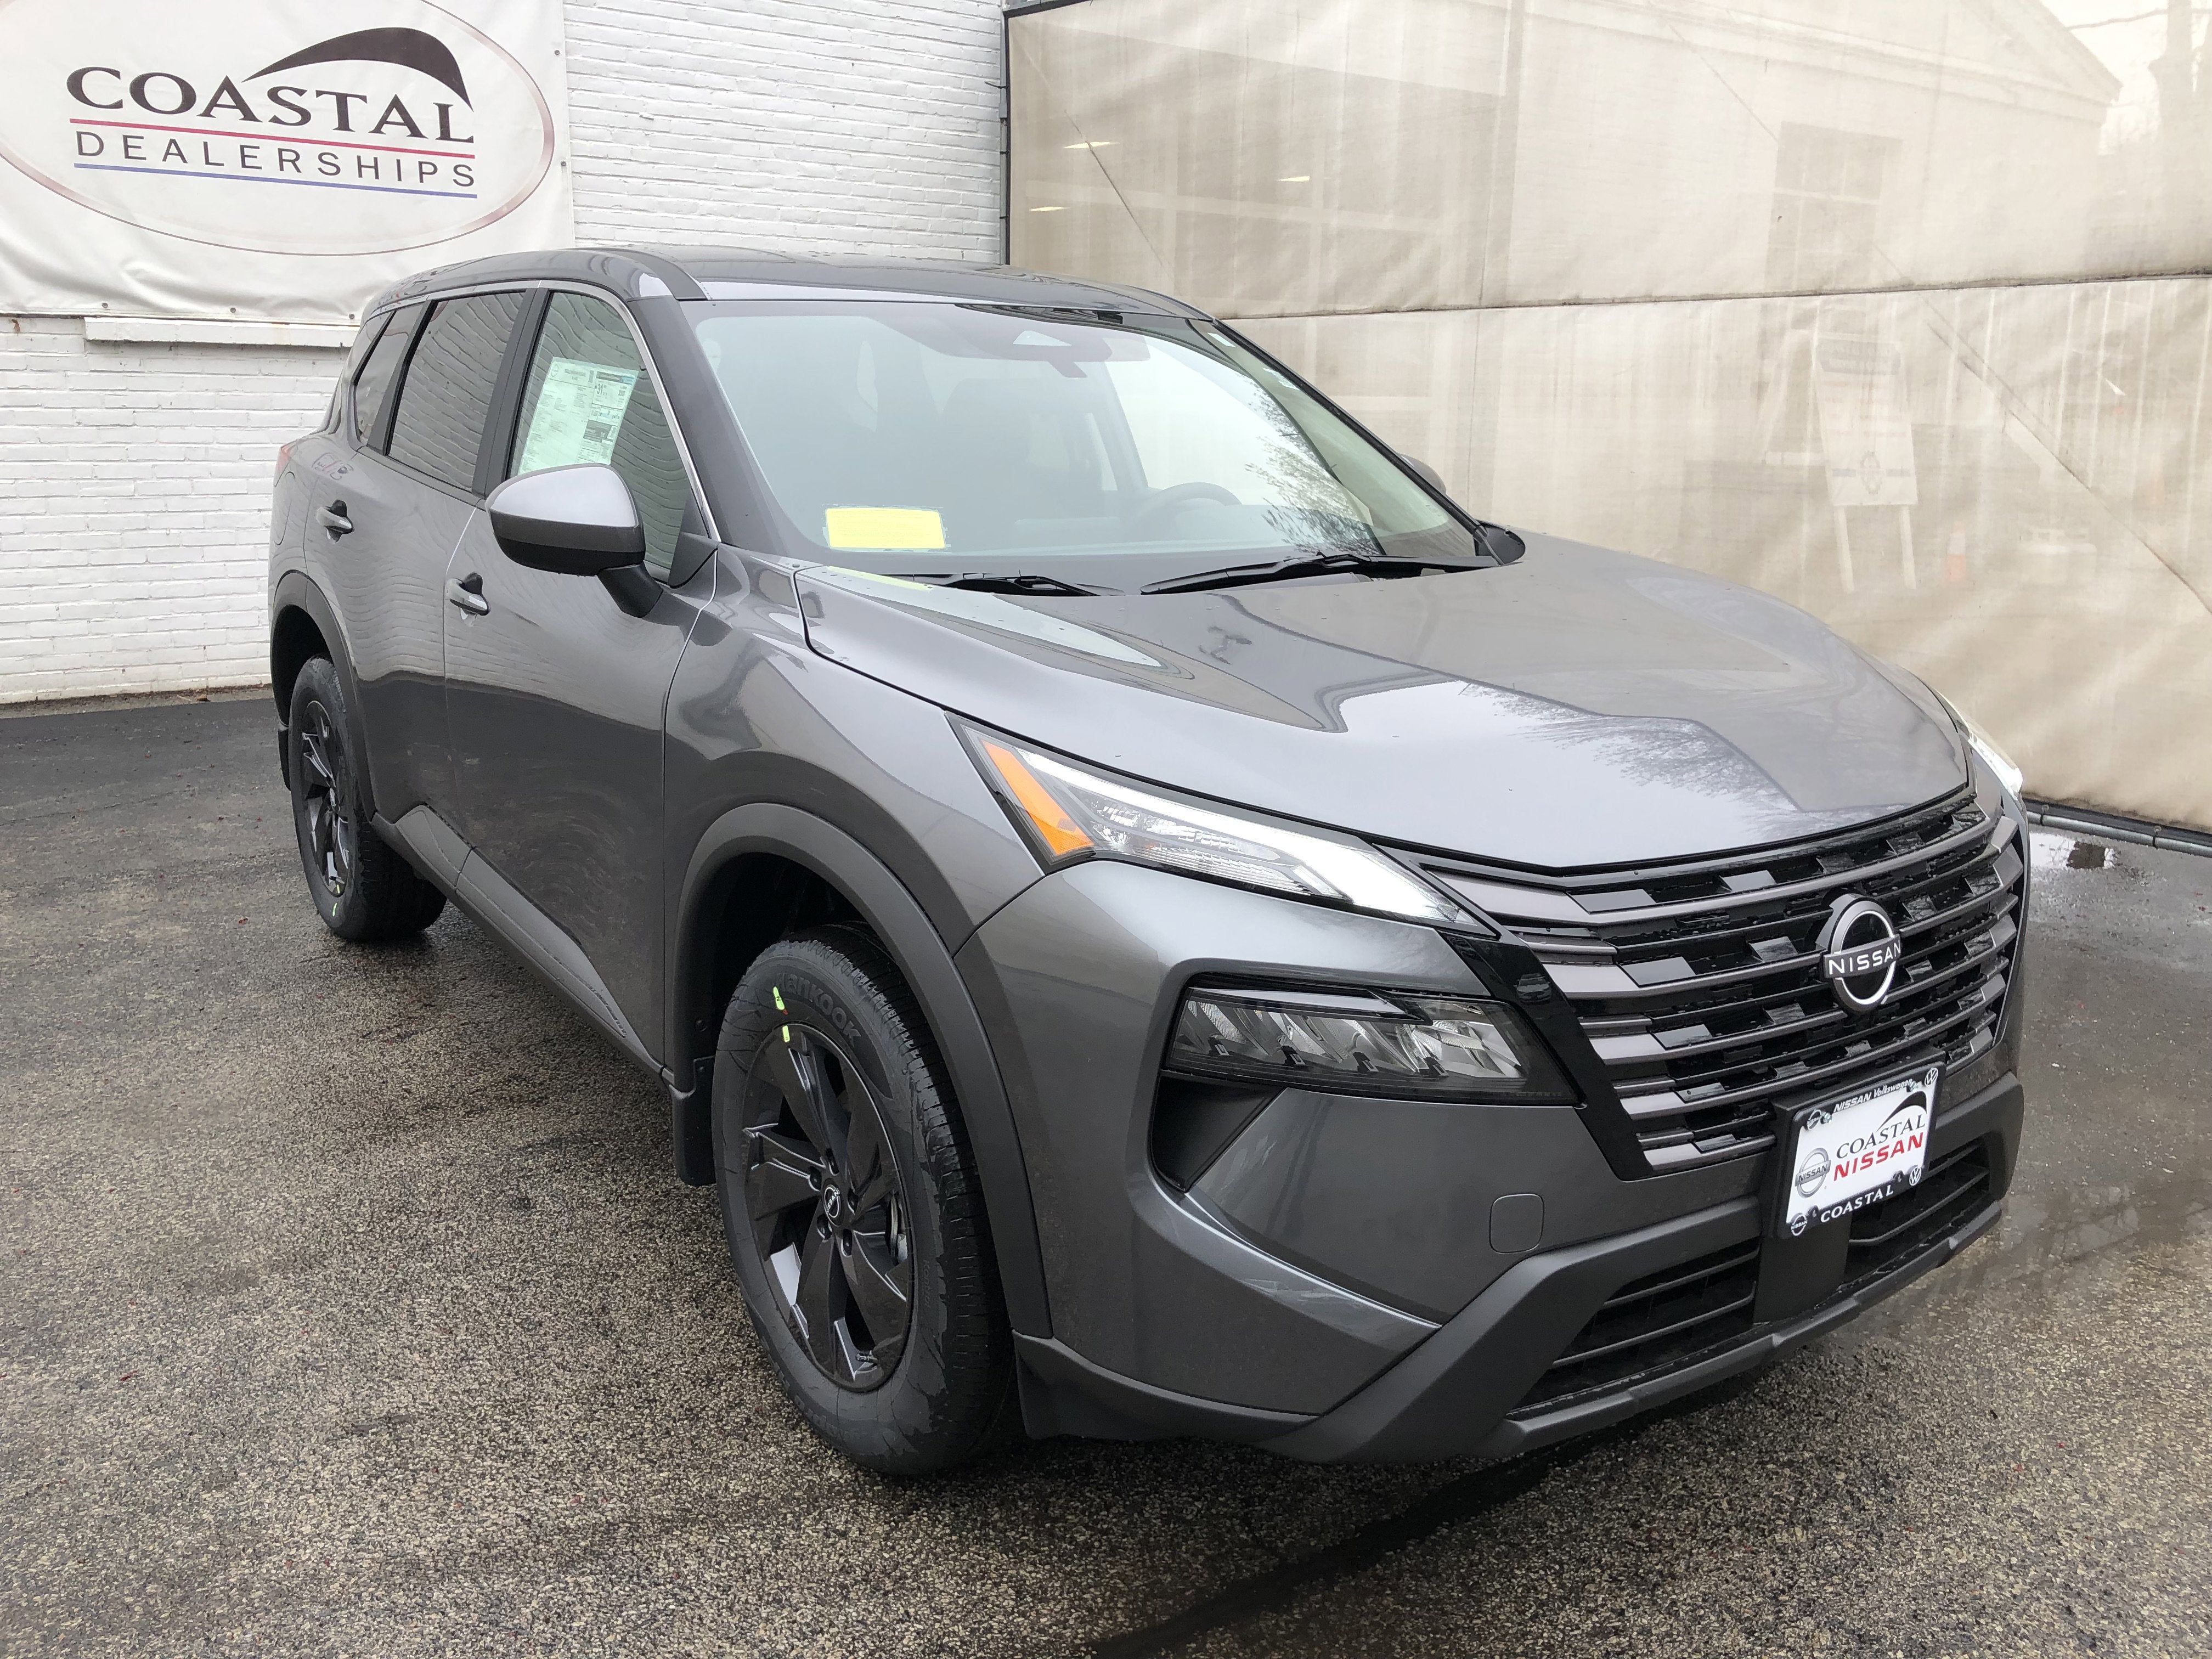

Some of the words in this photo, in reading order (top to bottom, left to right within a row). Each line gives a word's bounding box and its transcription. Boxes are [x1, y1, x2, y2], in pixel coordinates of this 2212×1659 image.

[67, 67, 474, 144] COASTAL
[77, 131, 475, 187] DEALERSHIPS
[1829, 939, 1901, 975] NISSAN
[1833, 1092, 1872, 1113] NISSAN
[1834, 1132, 1923, 1181] NISSAN
[1836, 1114, 1926, 1159] COASTAL
[1798, 1164, 1827, 1182] NISSAN
[1820, 1184, 1894, 1223] COASTAL
